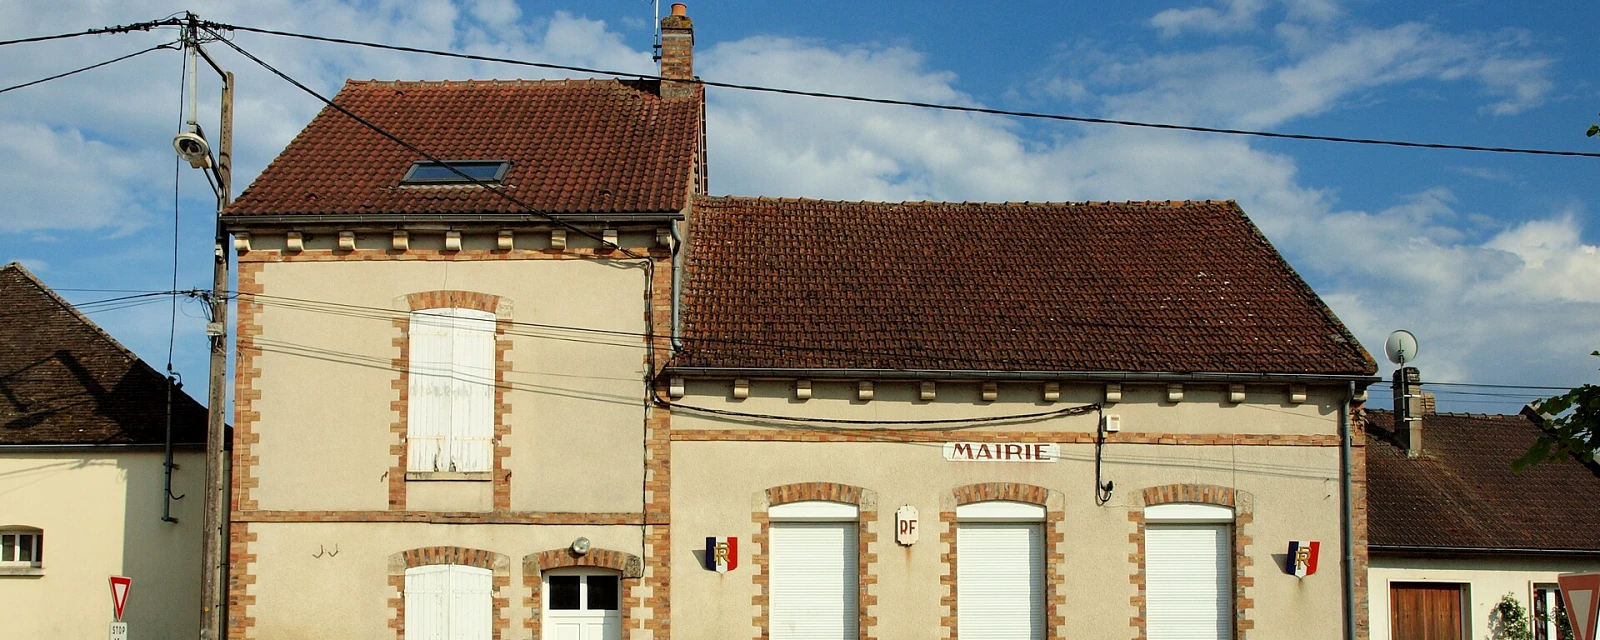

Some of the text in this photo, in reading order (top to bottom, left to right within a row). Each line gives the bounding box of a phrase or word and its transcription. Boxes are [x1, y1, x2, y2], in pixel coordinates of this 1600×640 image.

[952, 443, 1051, 460] MAIRIE
[900, 519, 917, 535] RF
[112, 625, 126, 635] STOP
